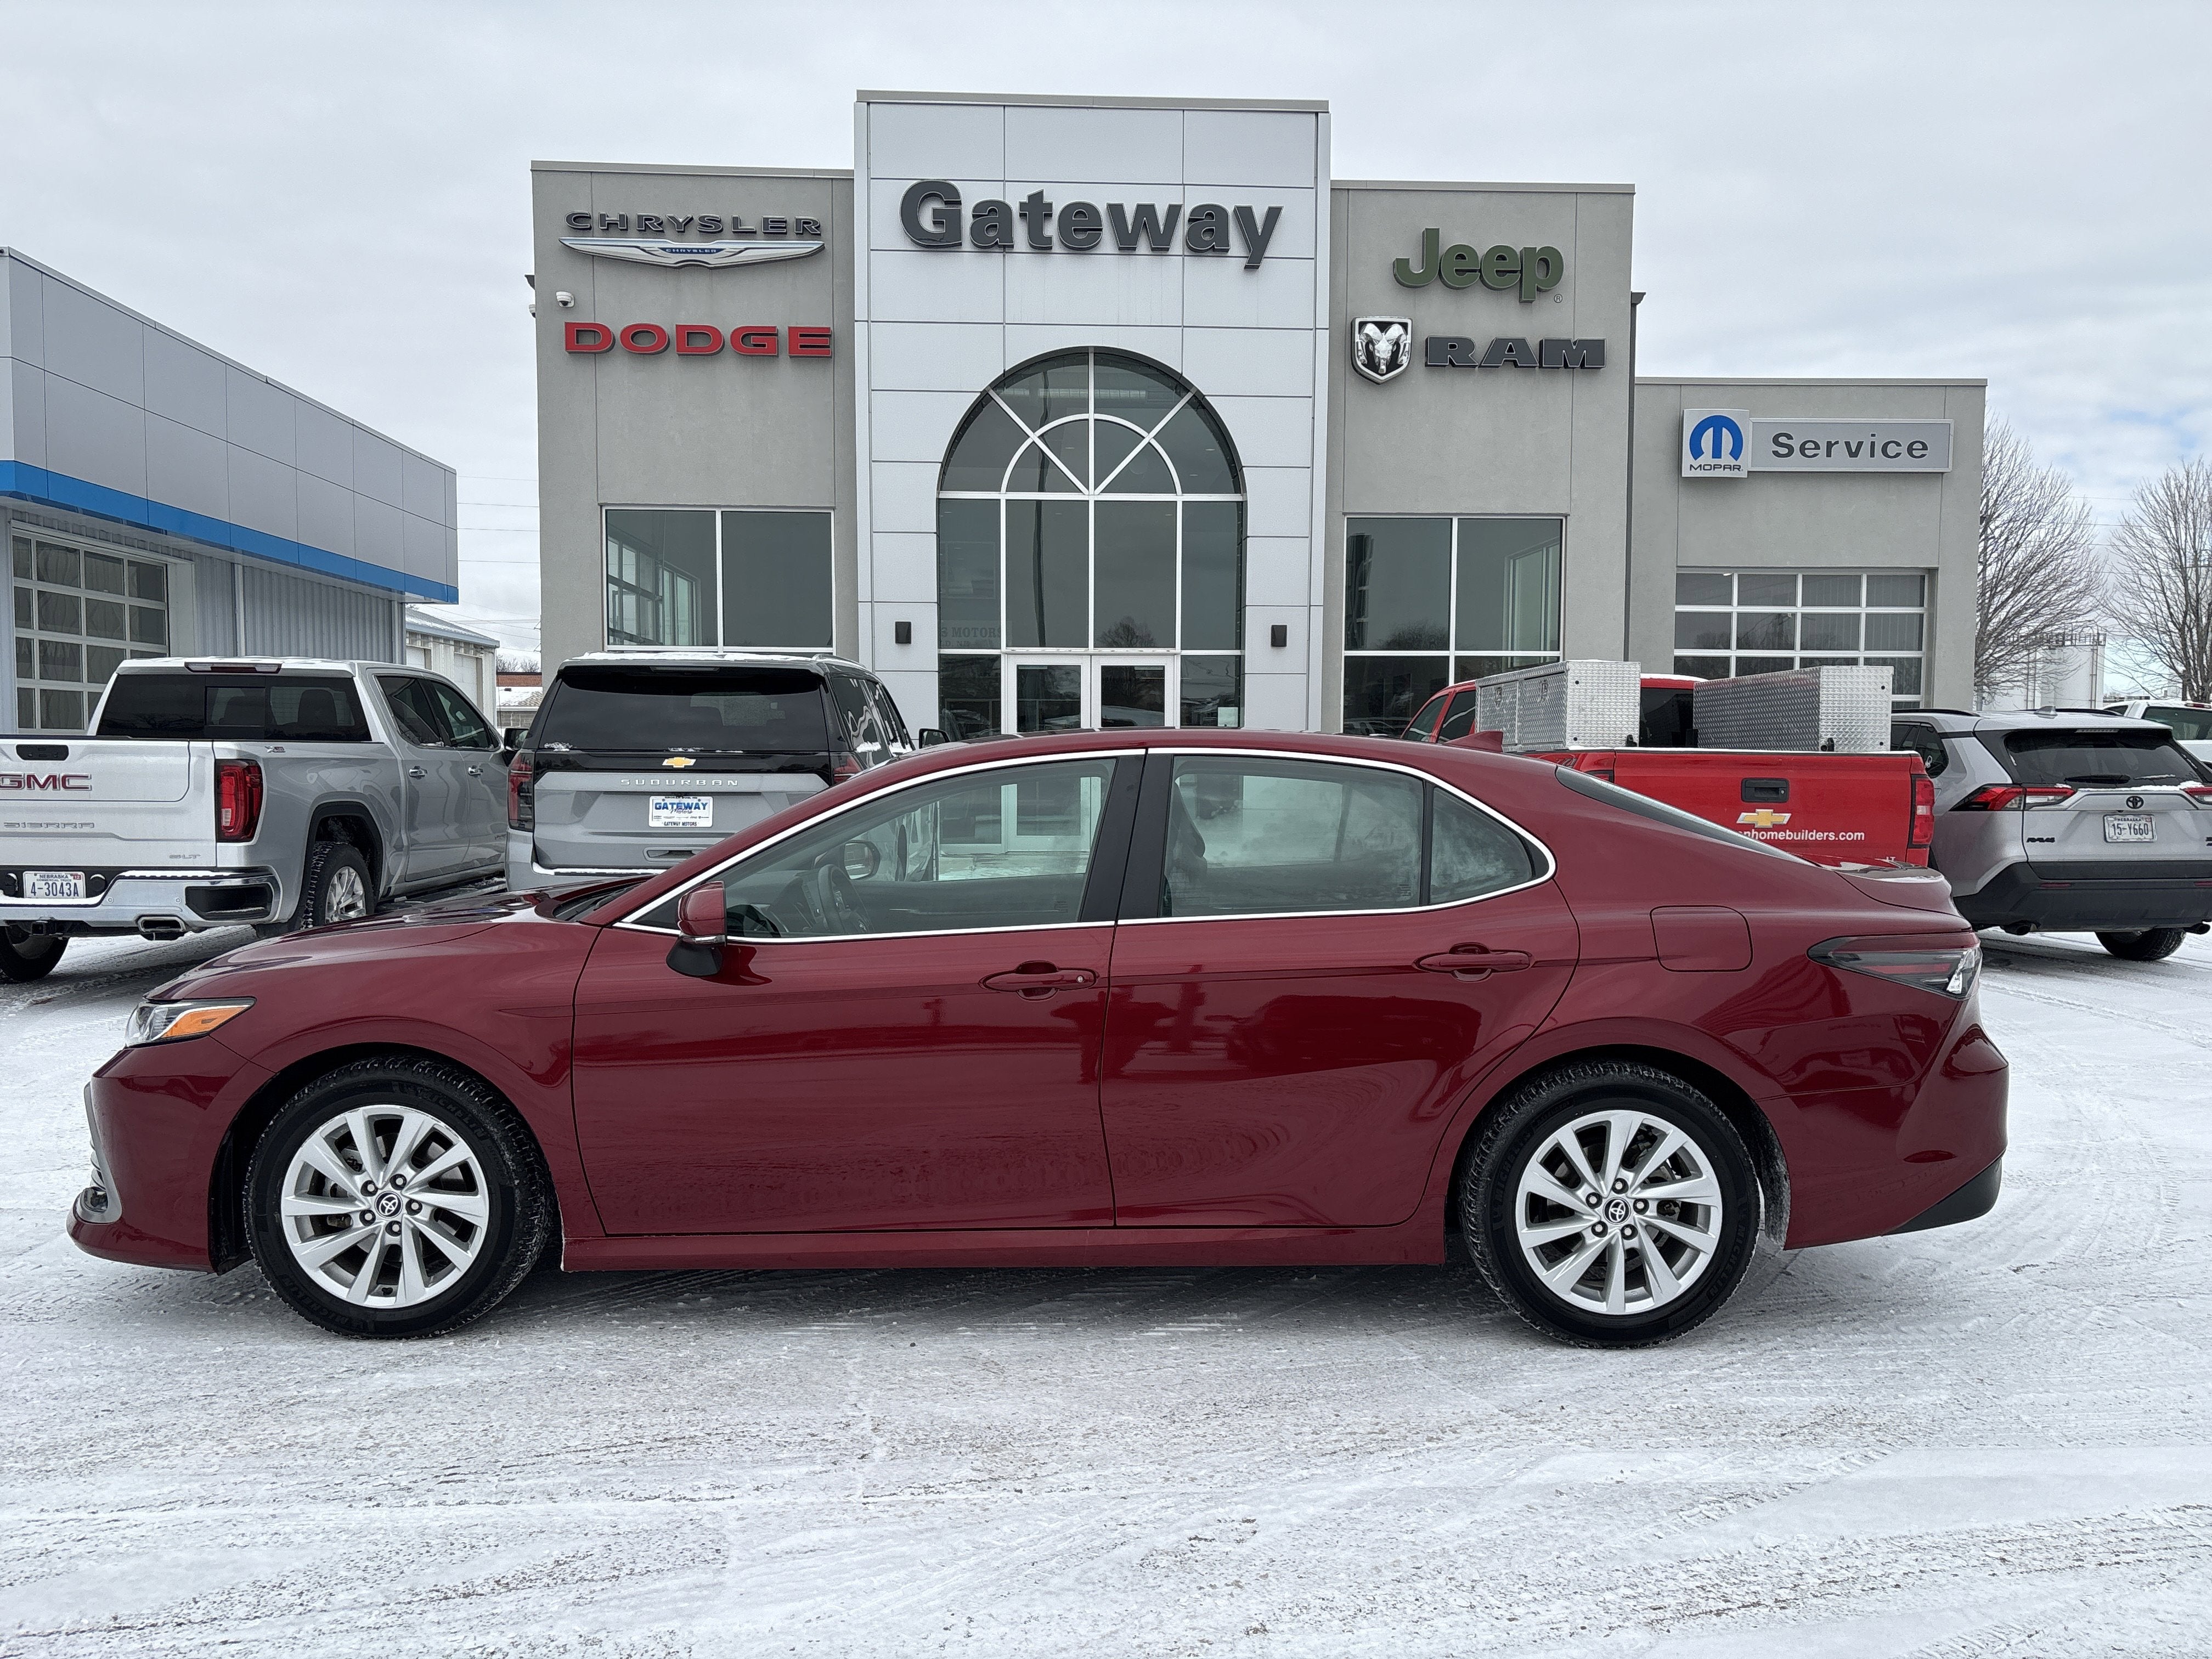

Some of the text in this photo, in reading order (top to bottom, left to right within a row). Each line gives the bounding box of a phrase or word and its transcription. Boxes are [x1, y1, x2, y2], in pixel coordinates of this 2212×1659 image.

[565, 211, 821, 235] CHRYSLER
[899, 179, 1284, 269] Gateway
[1392, 228, 1564, 303] Jeep
[565, 321, 832, 358] DODGE
[1425, 335, 1607, 369] RAM
[1771, 432, 1929, 459] Service
[1690, 464, 1741, 472] MOPAR
[0, 773, 92, 791] GMC
[1738, 828, 1865, 840] nhomebuilders.com
[2112, 823, 2149, 836] 15-Y660
[31, 882, 79, 896] 4-3043A
